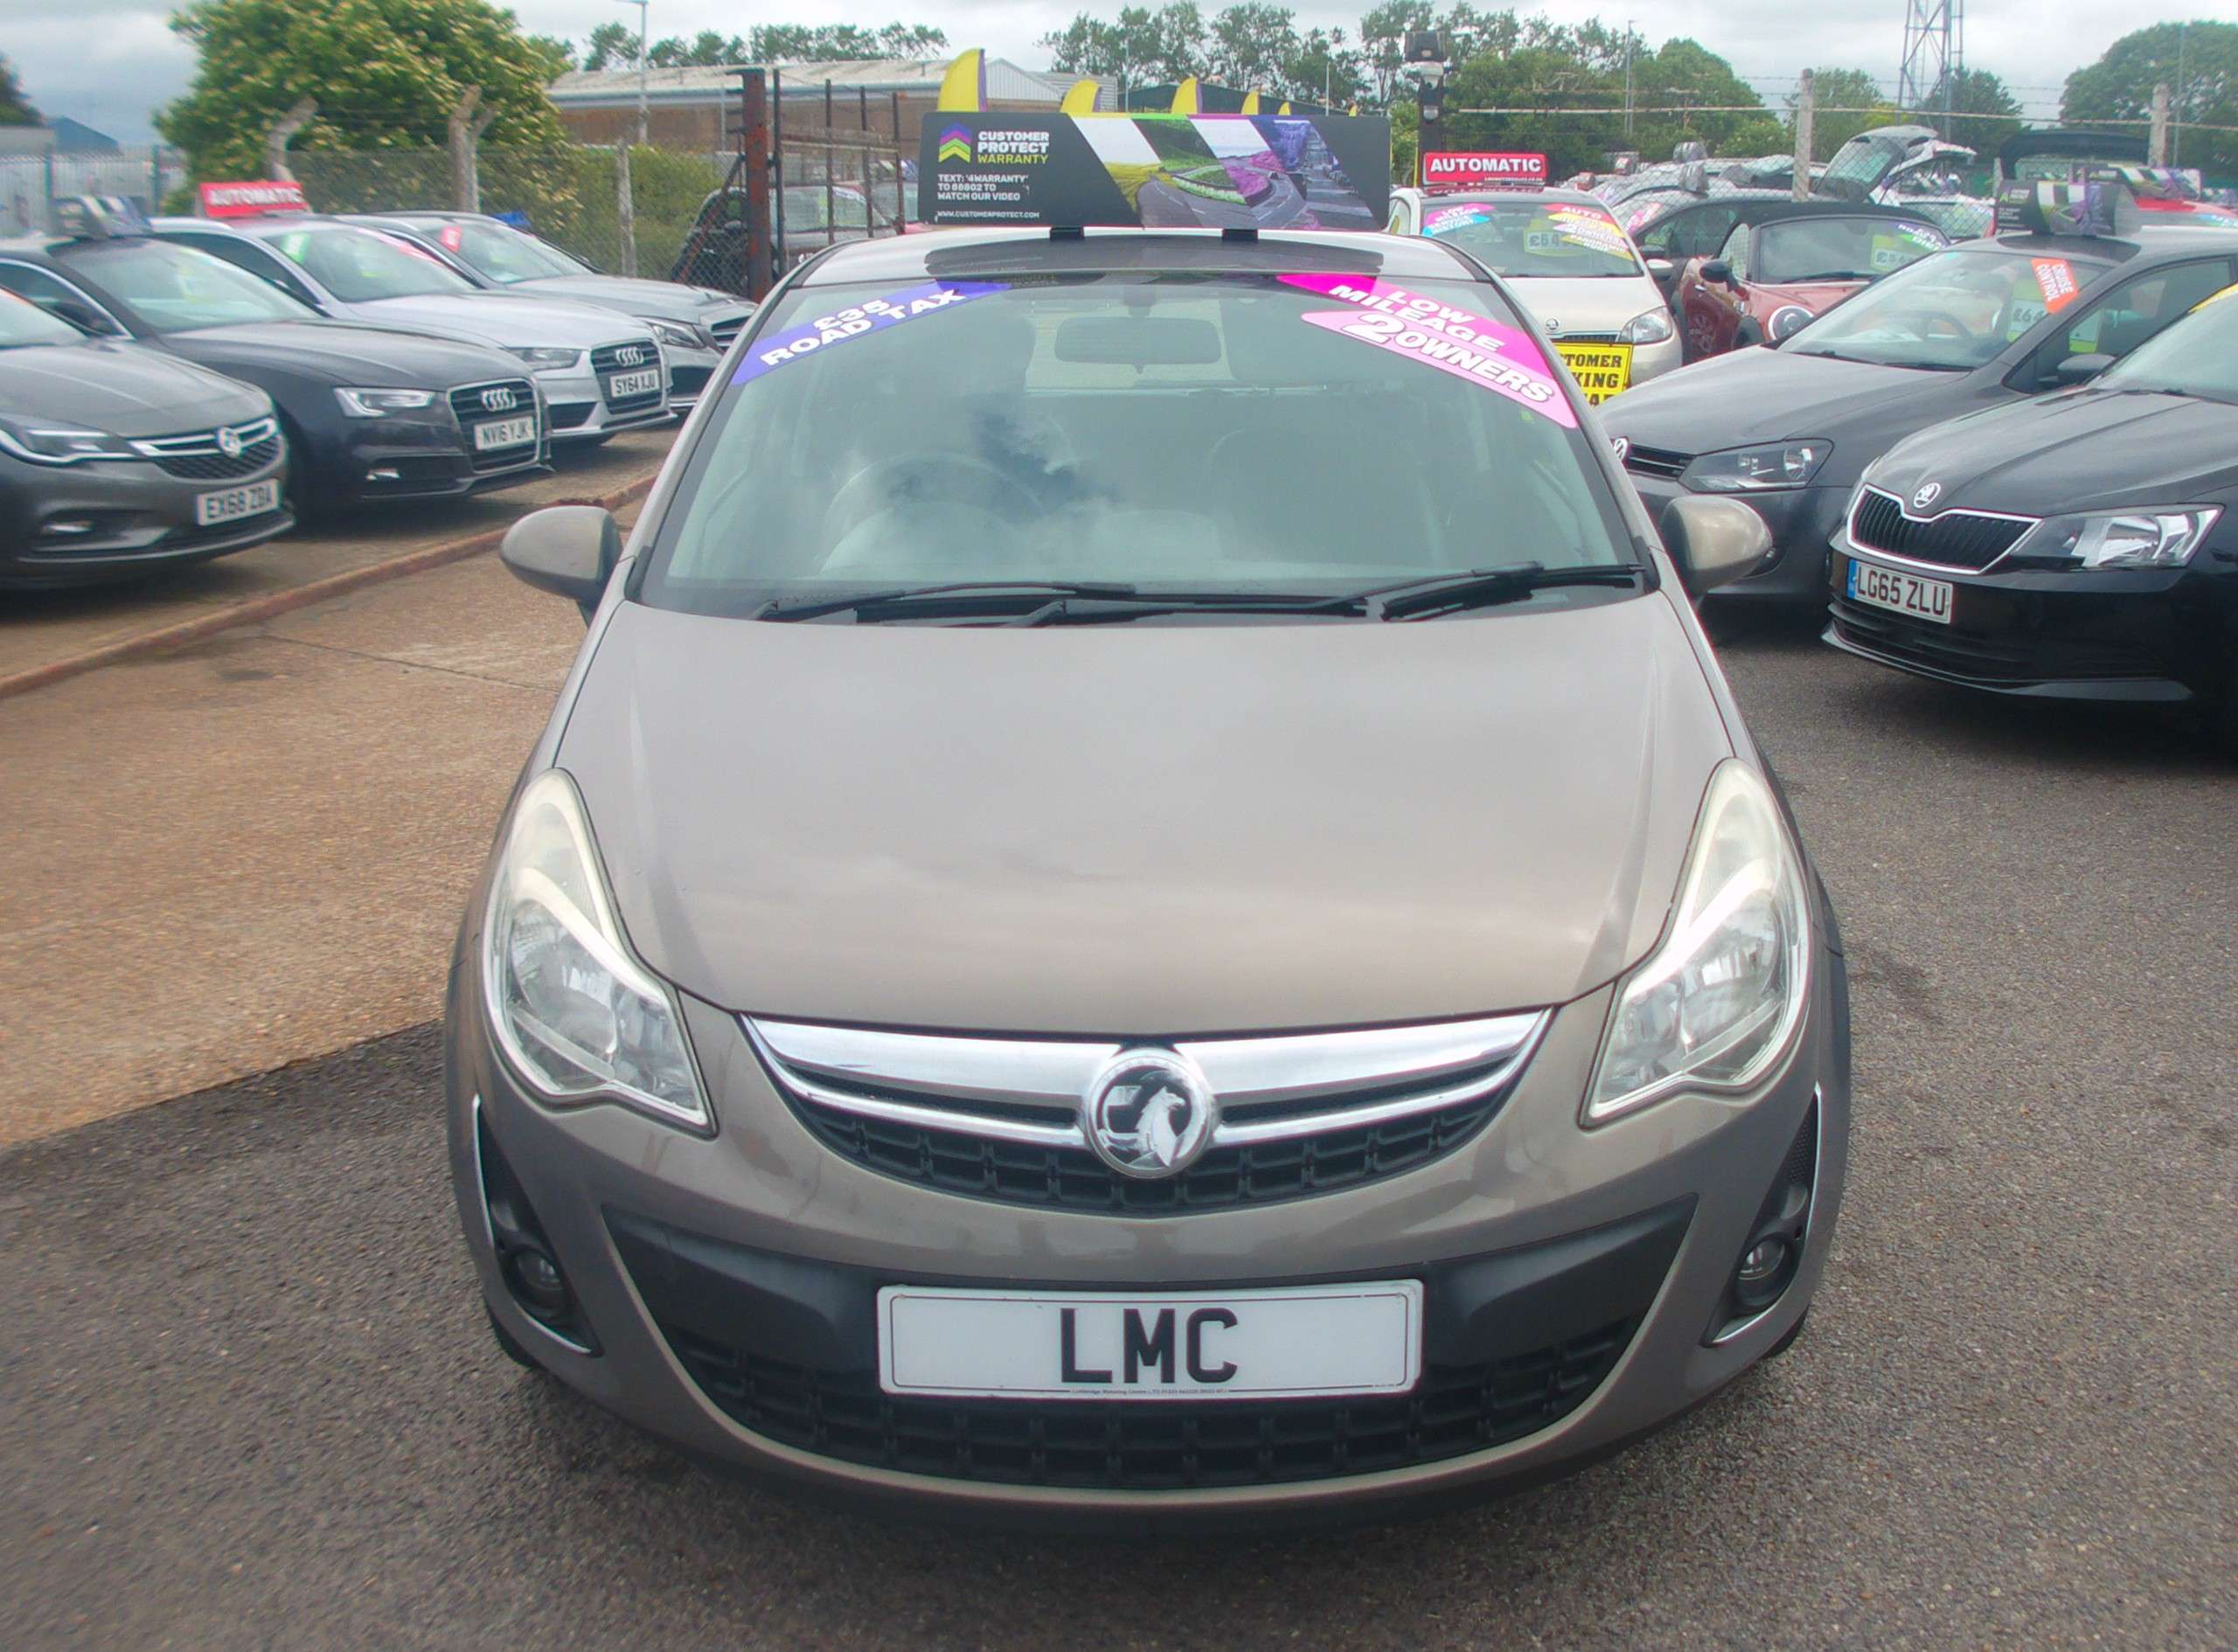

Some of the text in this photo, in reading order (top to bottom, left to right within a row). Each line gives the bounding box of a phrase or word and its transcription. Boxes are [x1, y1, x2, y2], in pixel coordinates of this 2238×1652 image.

[977, 142, 1049, 153] PROTECT
[978, 131, 1049, 141] CUSTOMER
[977, 154, 1049, 164] WARRANTY
[1429, 157, 1542, 172] AUTOMATIC
[937, 174, 964, 183] TEXT:
[993, 192, 1021, 201] VIDEO
[1560, 205, 1602, 219] AUTO
[2035, 264, 2061, 302] CONTROL
[2052, 263, 2075, 294] CRUISE
[812, 299, 890, 331] £35
[1328, 285, 1506, 352] MILEAGE
[1389, 290, 1476, 324] LOW
[760, 288, 966, 366] ROAD TAX
[1341, 314, 1554, 403] 2 OWNERS
[1560, 353, 1623, 368] TOMER
[205, 490, 247, 518] EX68
[1857, 566, 1946, 616] LG65 ZLU
[1060, 1307, 1238, 1384] LMC
